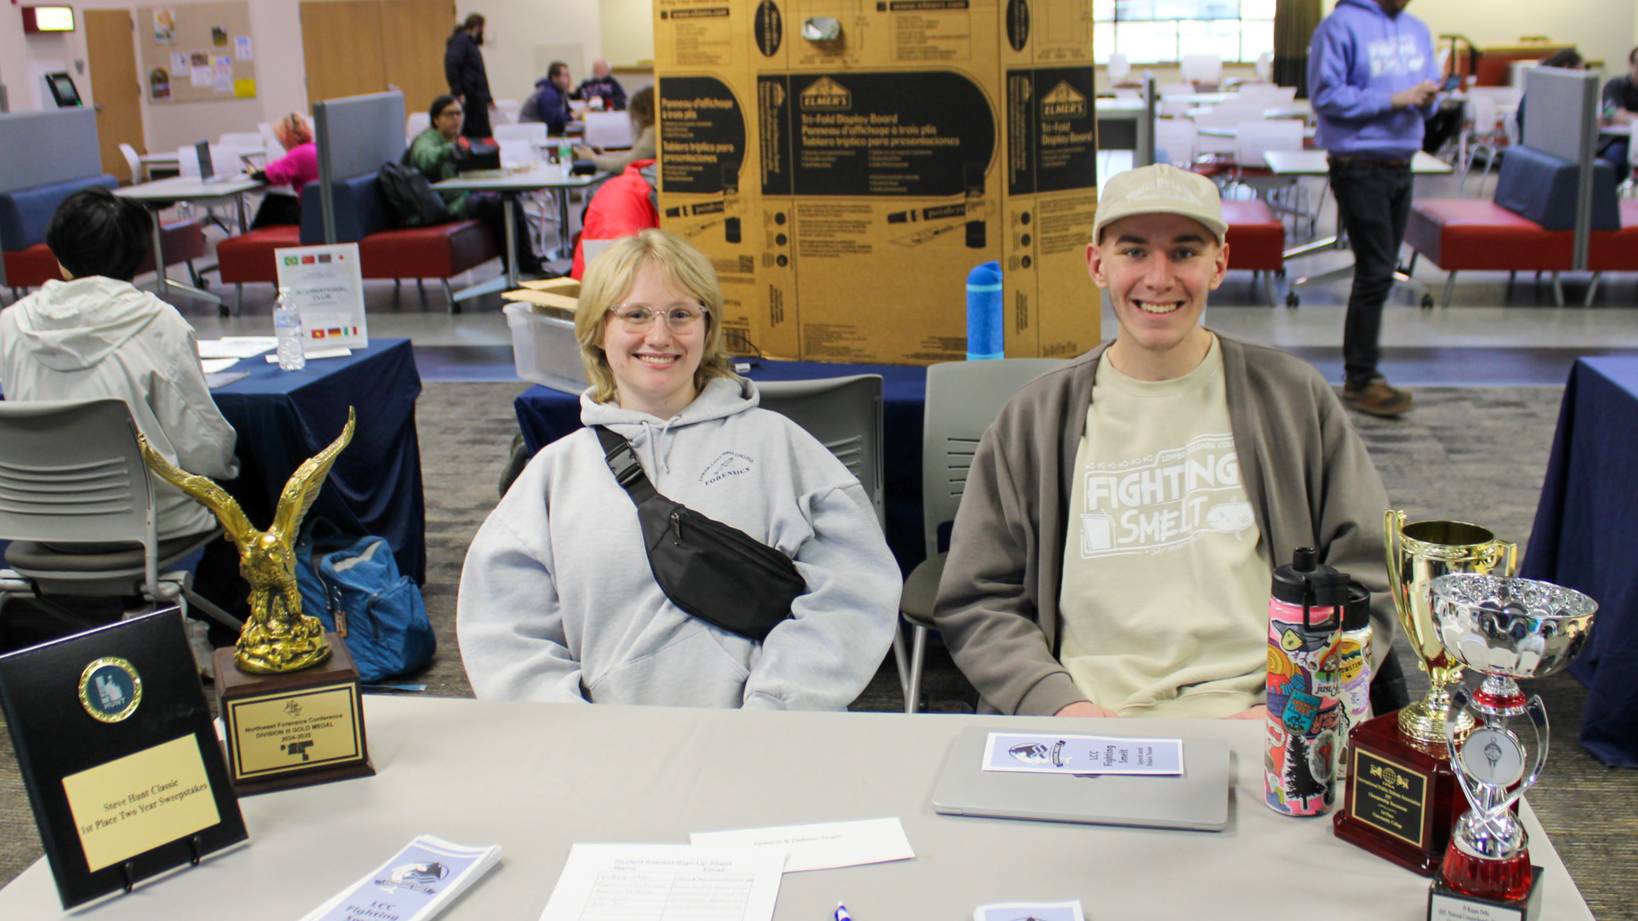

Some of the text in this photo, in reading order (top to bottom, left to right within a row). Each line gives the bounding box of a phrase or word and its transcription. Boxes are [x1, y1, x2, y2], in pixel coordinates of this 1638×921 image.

[804, 94, 847, 106] ELMER'S
[836, 114, 868, 125] Display
[869, 113, 898, 124] Board
[1087, 451, 1239, 511] FIGHTING
[1118, 496, 1208, 544] SMELT
[291, 725, 311, 733] GOLD
[311, 722, 335, 730] MEDAL
[1089, 750, 1098, 760] LCC
[1103, 745, 1117, 766] Fighting
[1118, 749, 1128, 763] Smelt
[103, 779, 179, 811] Steve Hunt Classic
[95, 815, 117, 829] Place
[119, 809, 137, 820] Two
[138, 801, 157, 813] Year
[158, 783, 208, 806] Sweepstakes
[345, 904, 400, 921] Fighting
[371, 901, 396, 911] LCC
